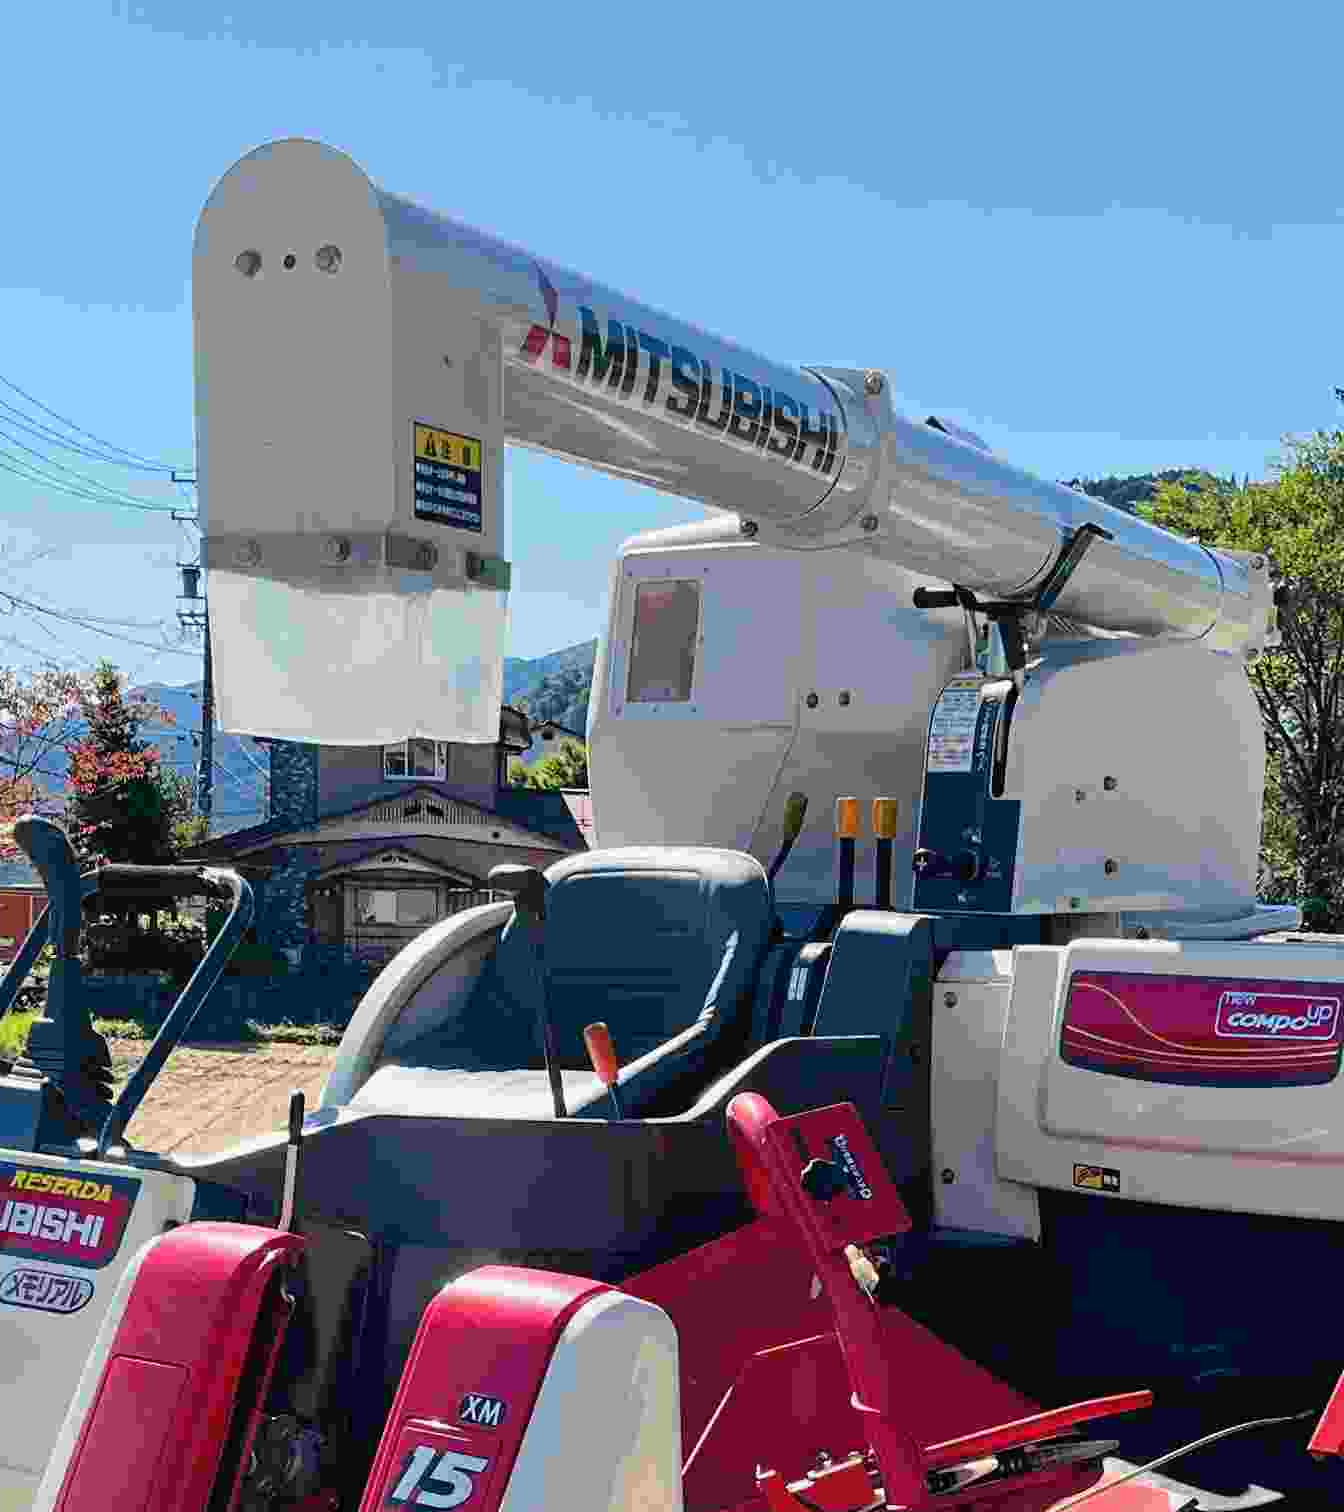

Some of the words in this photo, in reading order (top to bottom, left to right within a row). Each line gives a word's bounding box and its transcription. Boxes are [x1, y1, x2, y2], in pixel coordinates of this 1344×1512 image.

[575, 305, 838, 474] MITSUBISHI
[10, 1170, 113, 1202] RESERDA
[4, 1271, 83, 1309] メモリアル
[460, 1394, 503, 1426] XM
[391, 1445, 490, 1511] 15
